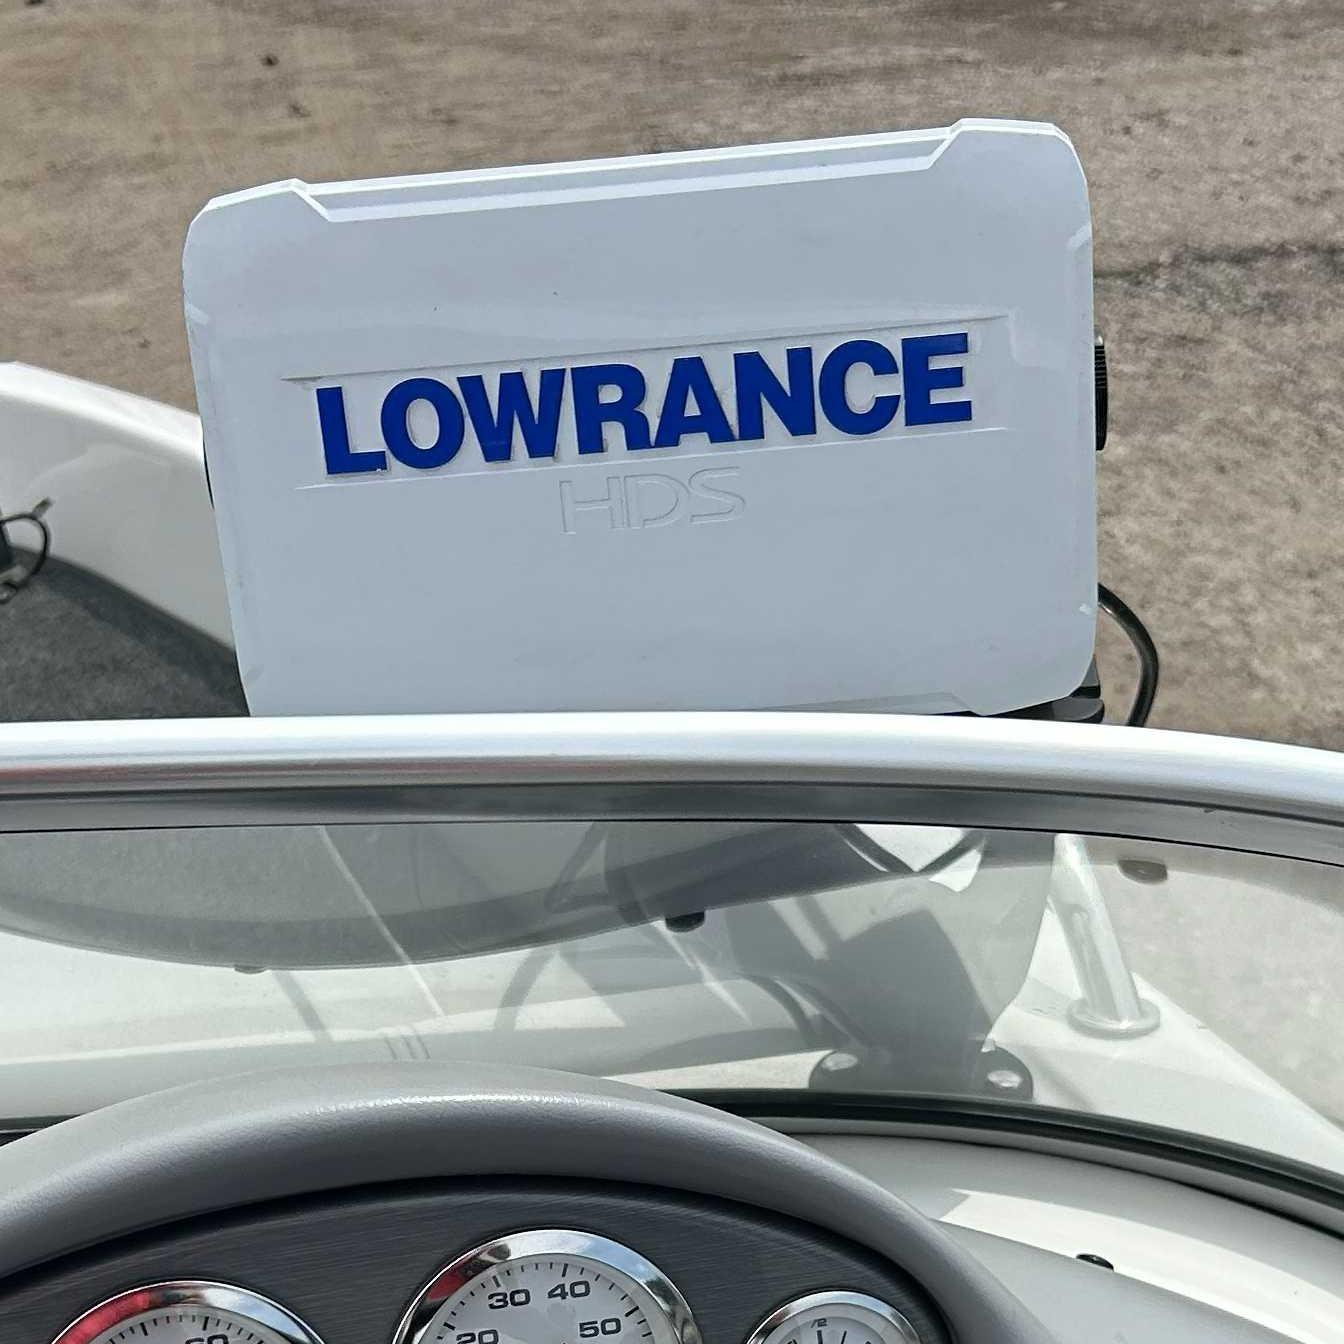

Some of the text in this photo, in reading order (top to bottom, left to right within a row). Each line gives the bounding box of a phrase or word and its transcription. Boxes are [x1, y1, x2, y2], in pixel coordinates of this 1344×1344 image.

[315, 331, 973, 477] LOWRANCE
[558, 466, 746, 535] HDS
[487, 1288, 531, 1310] 30
[546, 1280, 591, 1300] 40
[578, 1317, 622, 1338] 50
